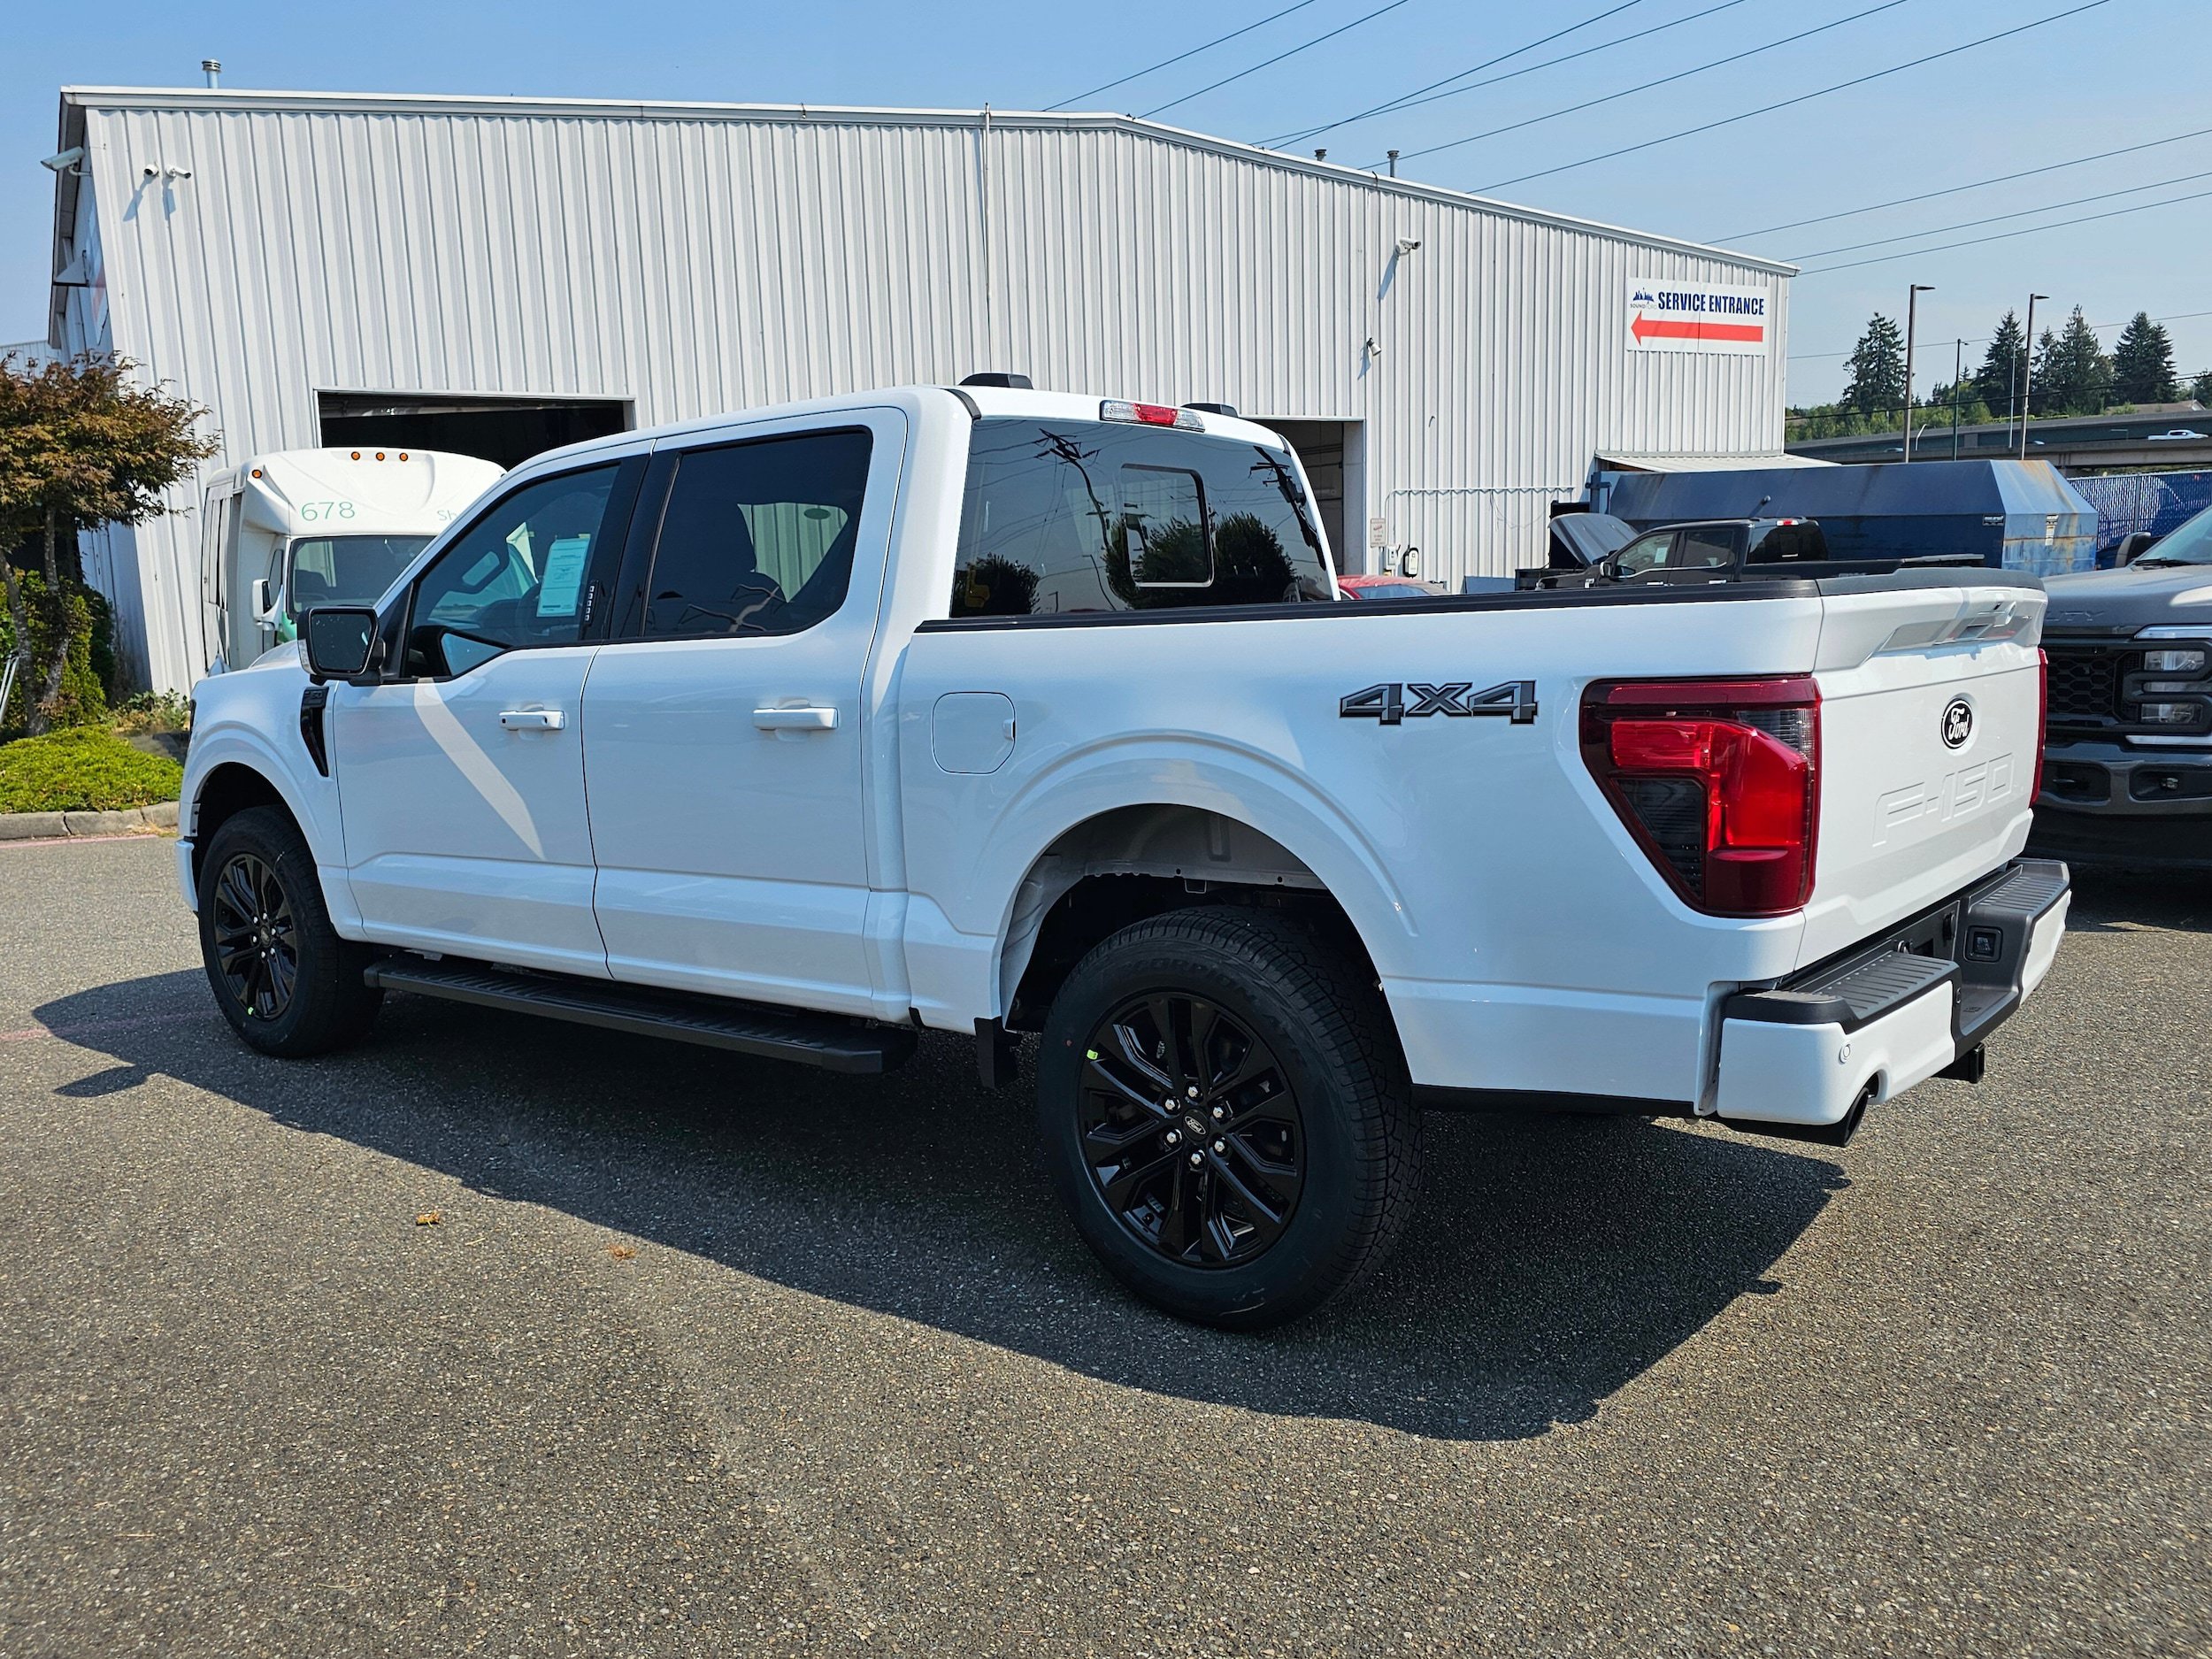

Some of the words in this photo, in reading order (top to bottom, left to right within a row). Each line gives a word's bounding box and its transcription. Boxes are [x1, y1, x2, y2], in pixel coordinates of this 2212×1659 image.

[1658, 291, 1706, 311] SERVICE
[1709, 295, 1764, 315] ENTRANCE
[301, 501, 356, 521] 678
[1947, 706, 1970, 741] Ford
[1871, 752, 2015, 848] F-150
[1187, 1118, 1204, 1133] Ford
